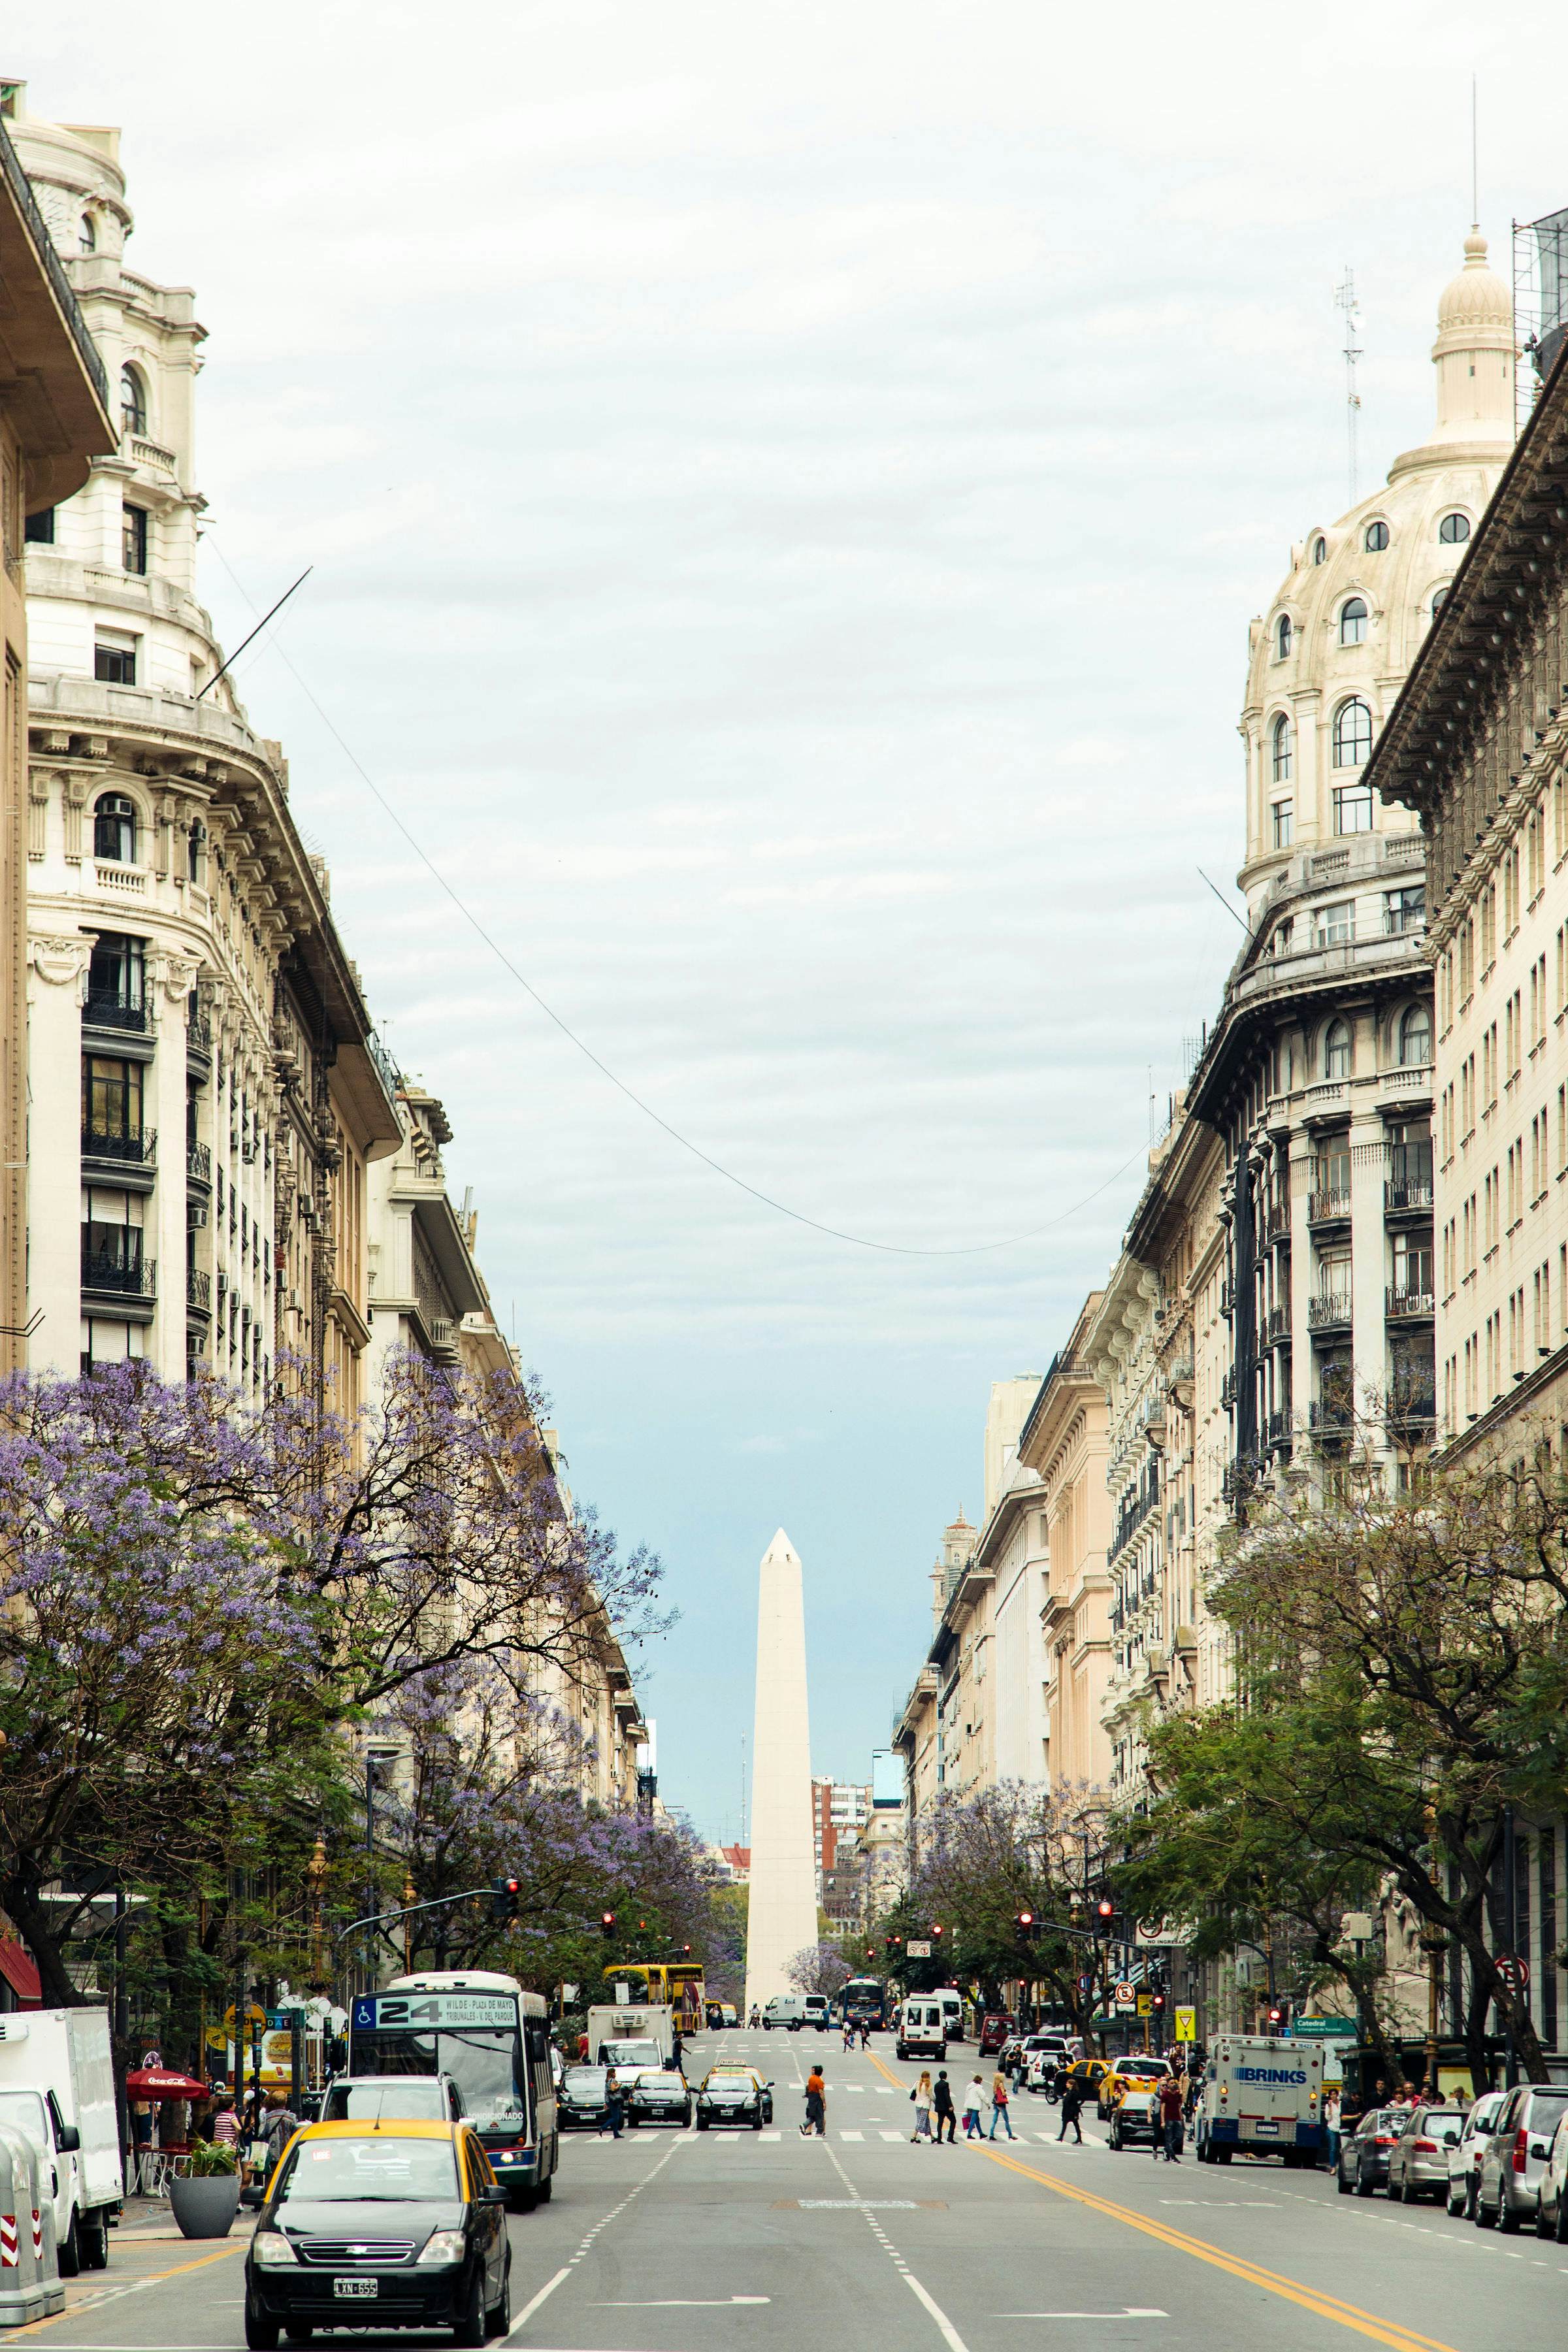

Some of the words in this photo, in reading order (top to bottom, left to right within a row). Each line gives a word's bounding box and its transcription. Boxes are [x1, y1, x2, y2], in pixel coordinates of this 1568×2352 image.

[446, 2000, 468, 2010] WILDE
[489, 2000, 496, 2010] DE
[497, 2000, 513, 2010] MAYO
[380, 2001, 442, 2024] 24
[446, 2012, 476, 2021] TRIBUNALES
[485, 2012, 494, 2021] DEL
[495, 2012, 514, 2021] PARQUE
[1243, 2067, 1307, 2084] BRINKS
[148, 2077, 187, 2086] Coca-Cola
[336, 2283, 353, 2294] LXN
[358, 2283, 376, 2295] 655
